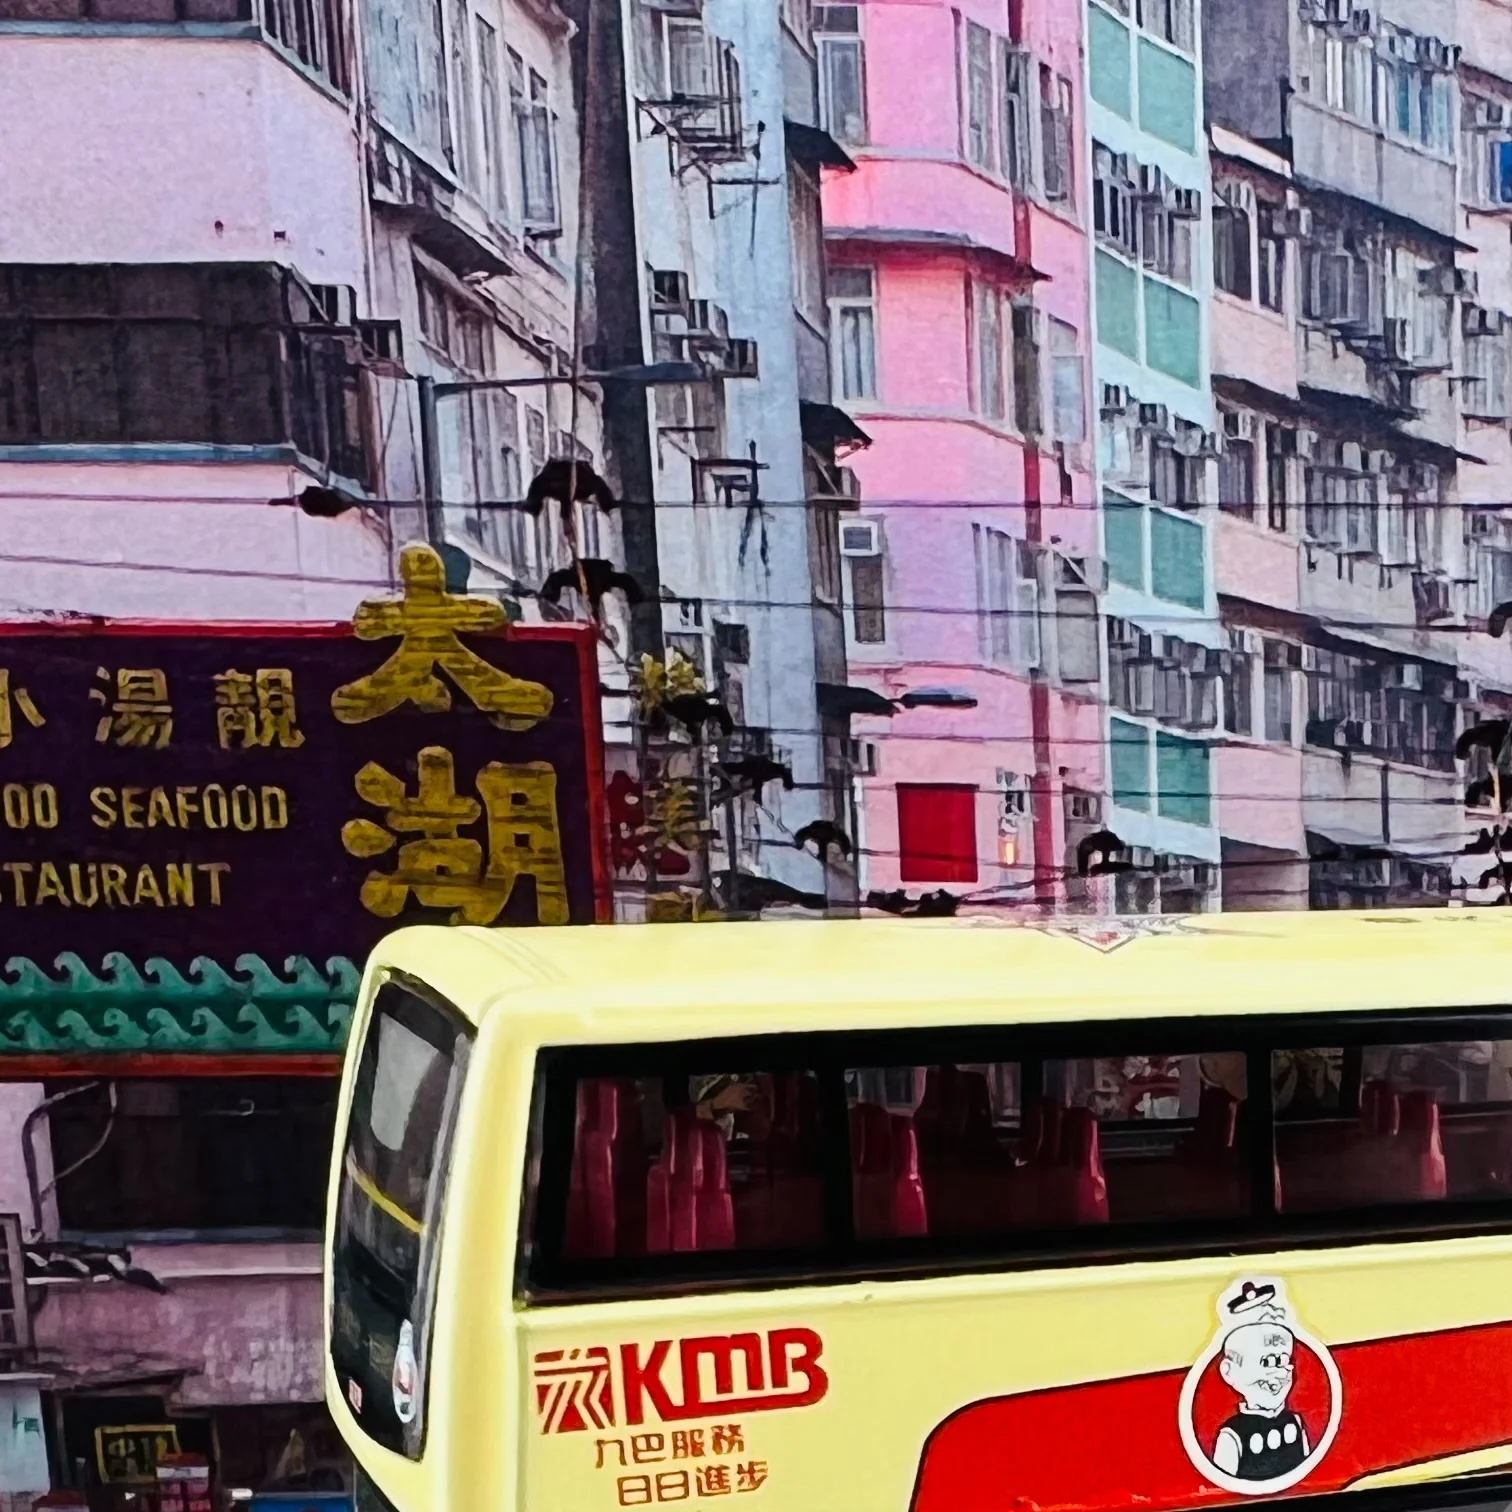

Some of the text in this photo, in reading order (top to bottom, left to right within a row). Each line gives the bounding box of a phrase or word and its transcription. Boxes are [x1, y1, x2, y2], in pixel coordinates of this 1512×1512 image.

[90, 783, 288, 831] SEAFOOD
[0, 862, 231, 908] TAURANT
[617, 1461, 769, 1506] 日日進步
